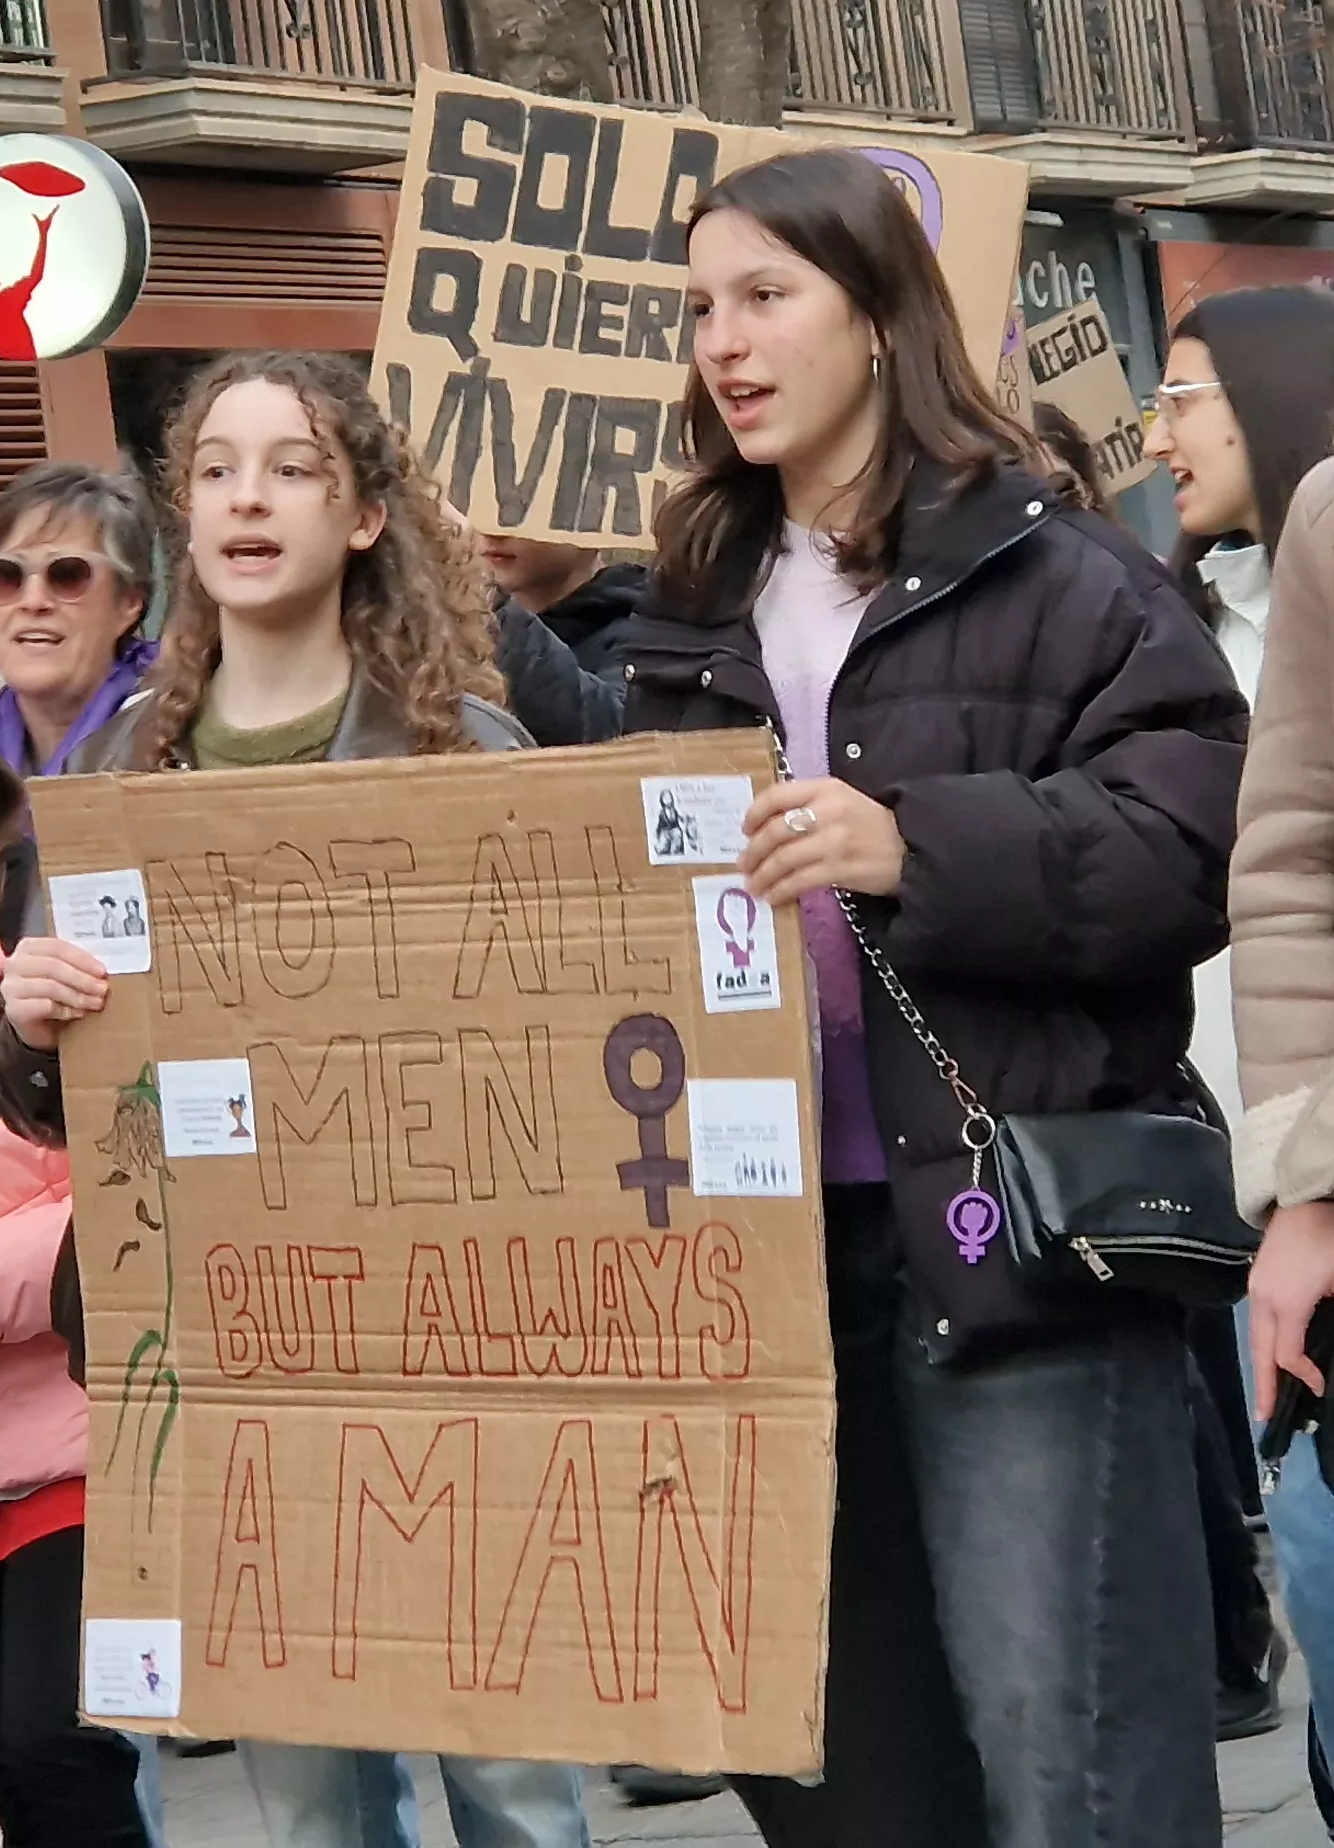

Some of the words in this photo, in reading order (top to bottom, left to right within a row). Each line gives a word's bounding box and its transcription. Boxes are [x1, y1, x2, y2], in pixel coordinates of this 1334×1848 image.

[420, 91, 720, 265] SOLO
[1014, 250, 1097, 308] che
[145, 838, 417, 1014] NOT
[452, 824, 673, 1002] ALL
[246, 1024, 564, 1211] MEN
[205, 1243, 364, 1379] BUT
[402, 1222, 751, 1382] ALWAYS
[205, 1418, 287, 1668] A
[331, 1413, 756, 1714] MAN
